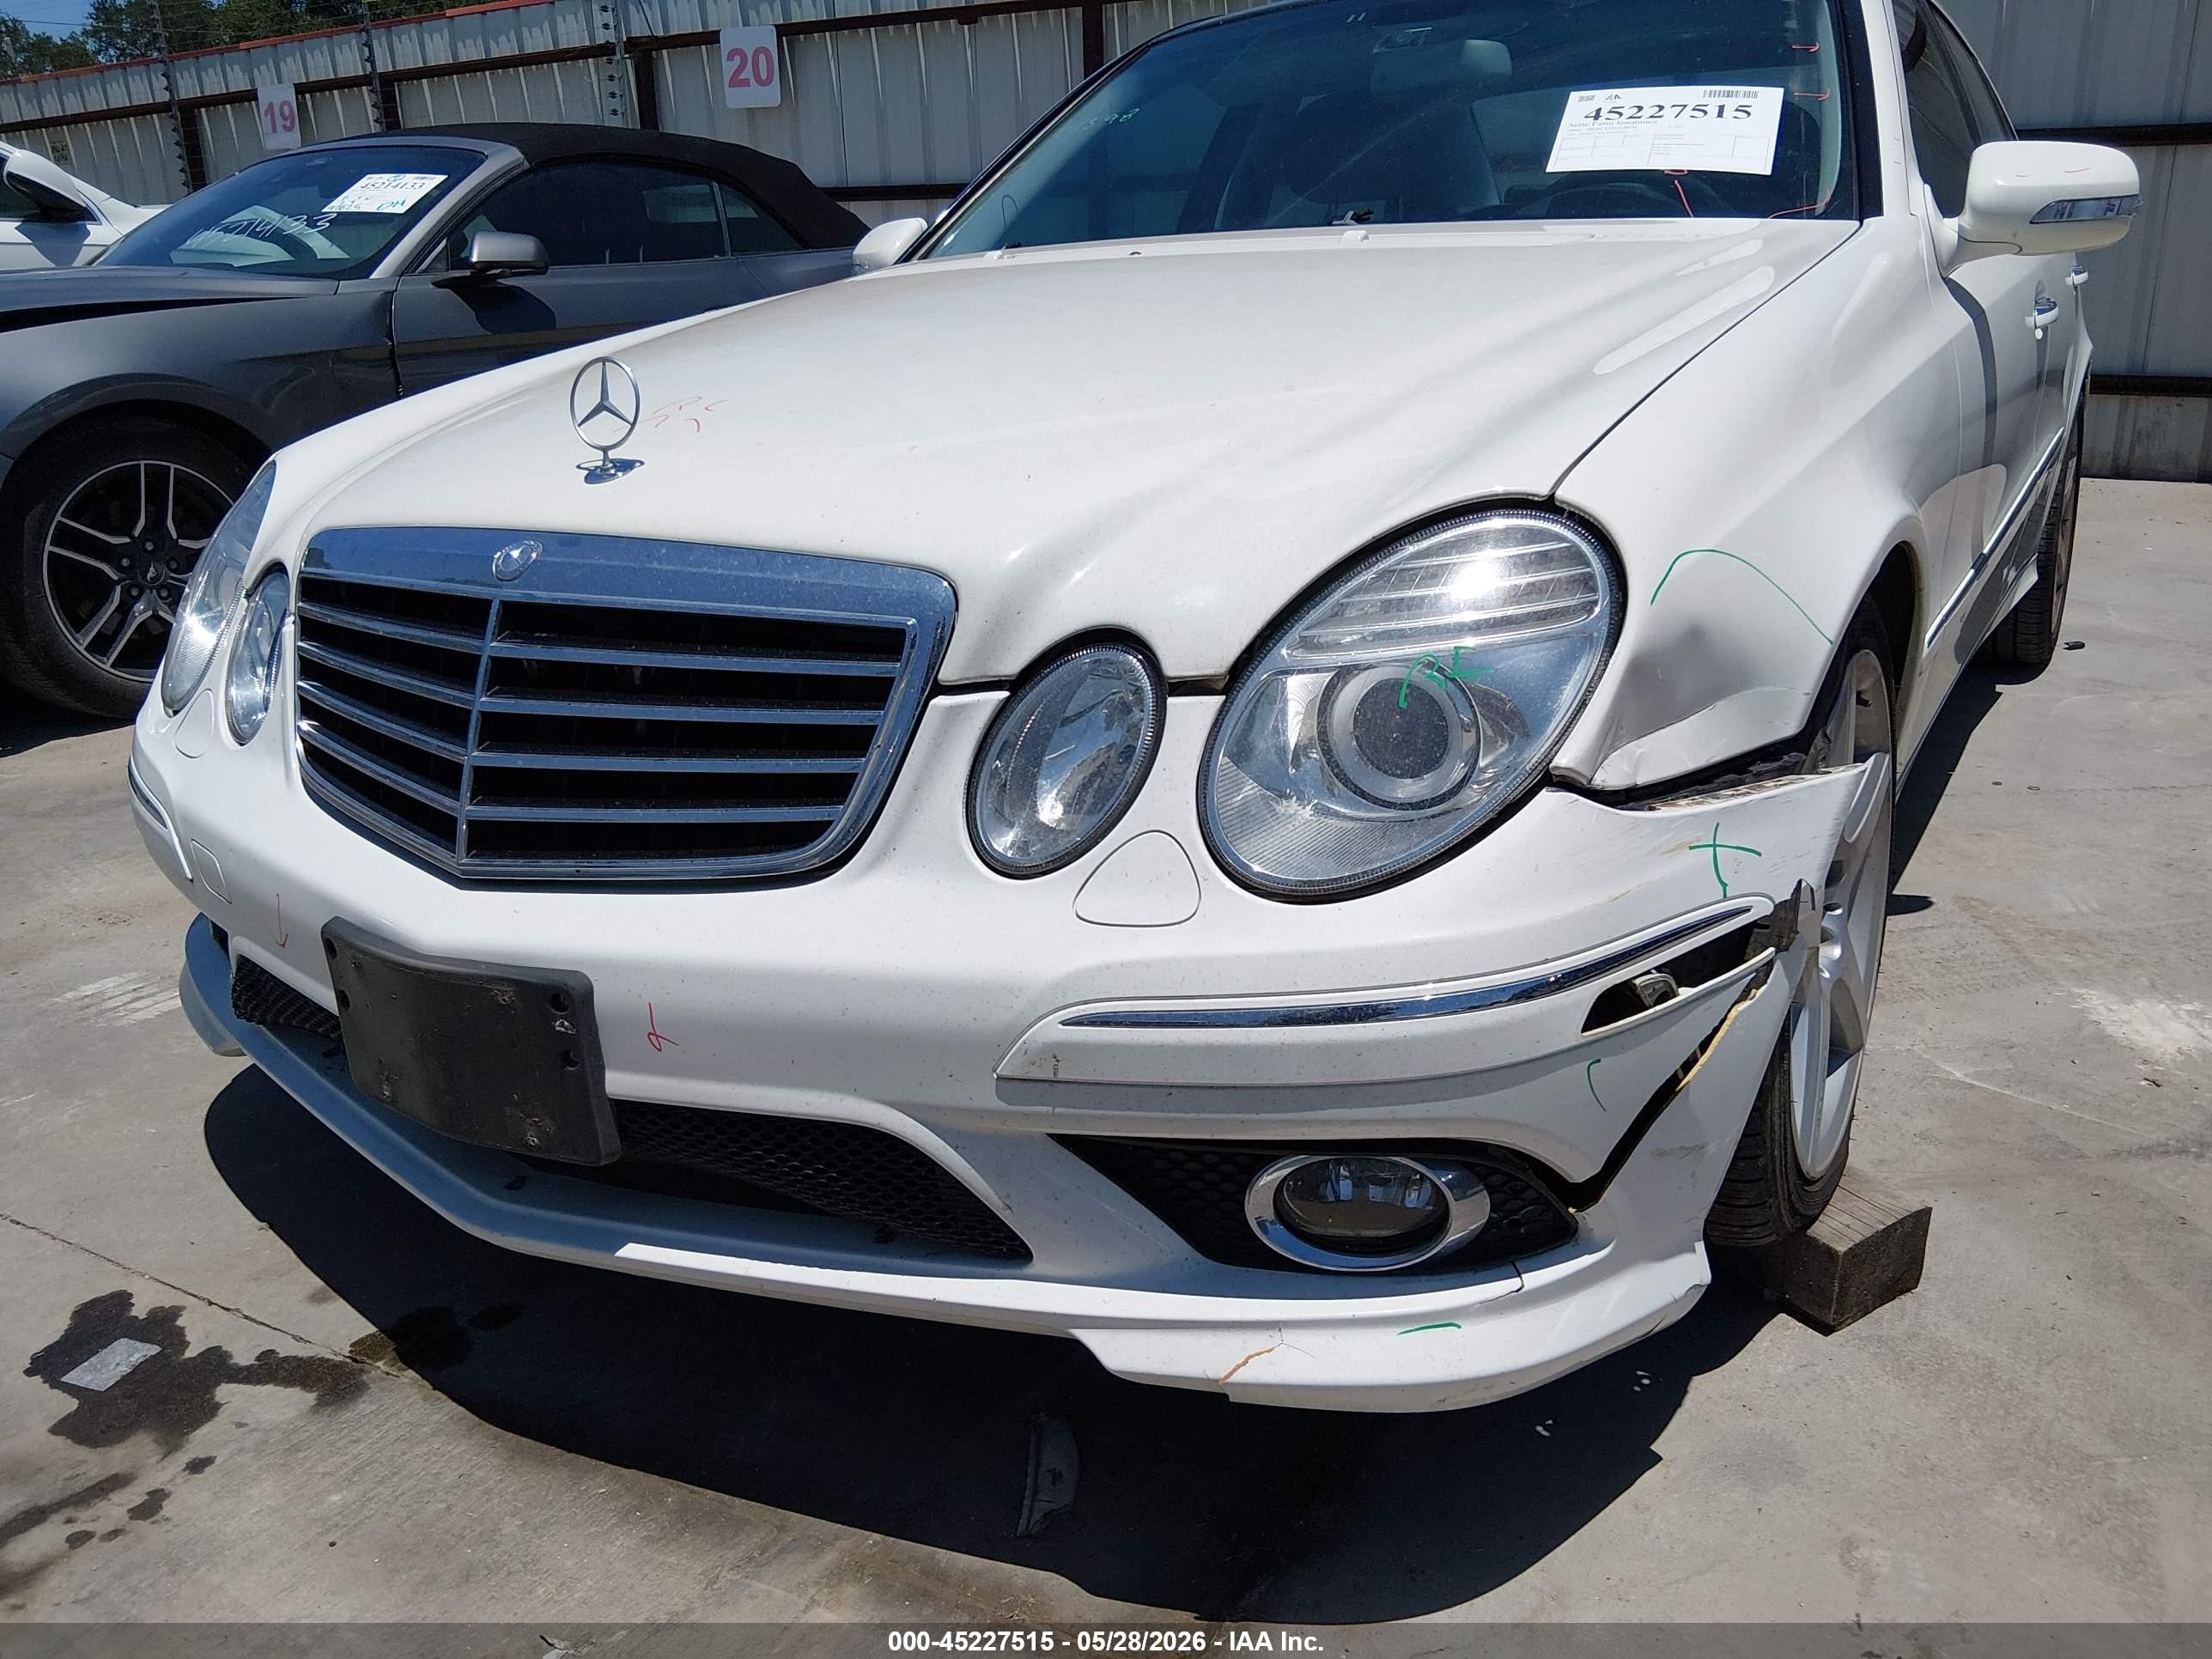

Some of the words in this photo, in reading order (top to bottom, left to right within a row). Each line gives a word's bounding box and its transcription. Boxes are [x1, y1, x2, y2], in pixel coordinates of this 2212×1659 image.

[726, 46, 775, 88] 20
[264, 100, 296, 134] 19
[1583, 104, 1753, 121] 45227515
